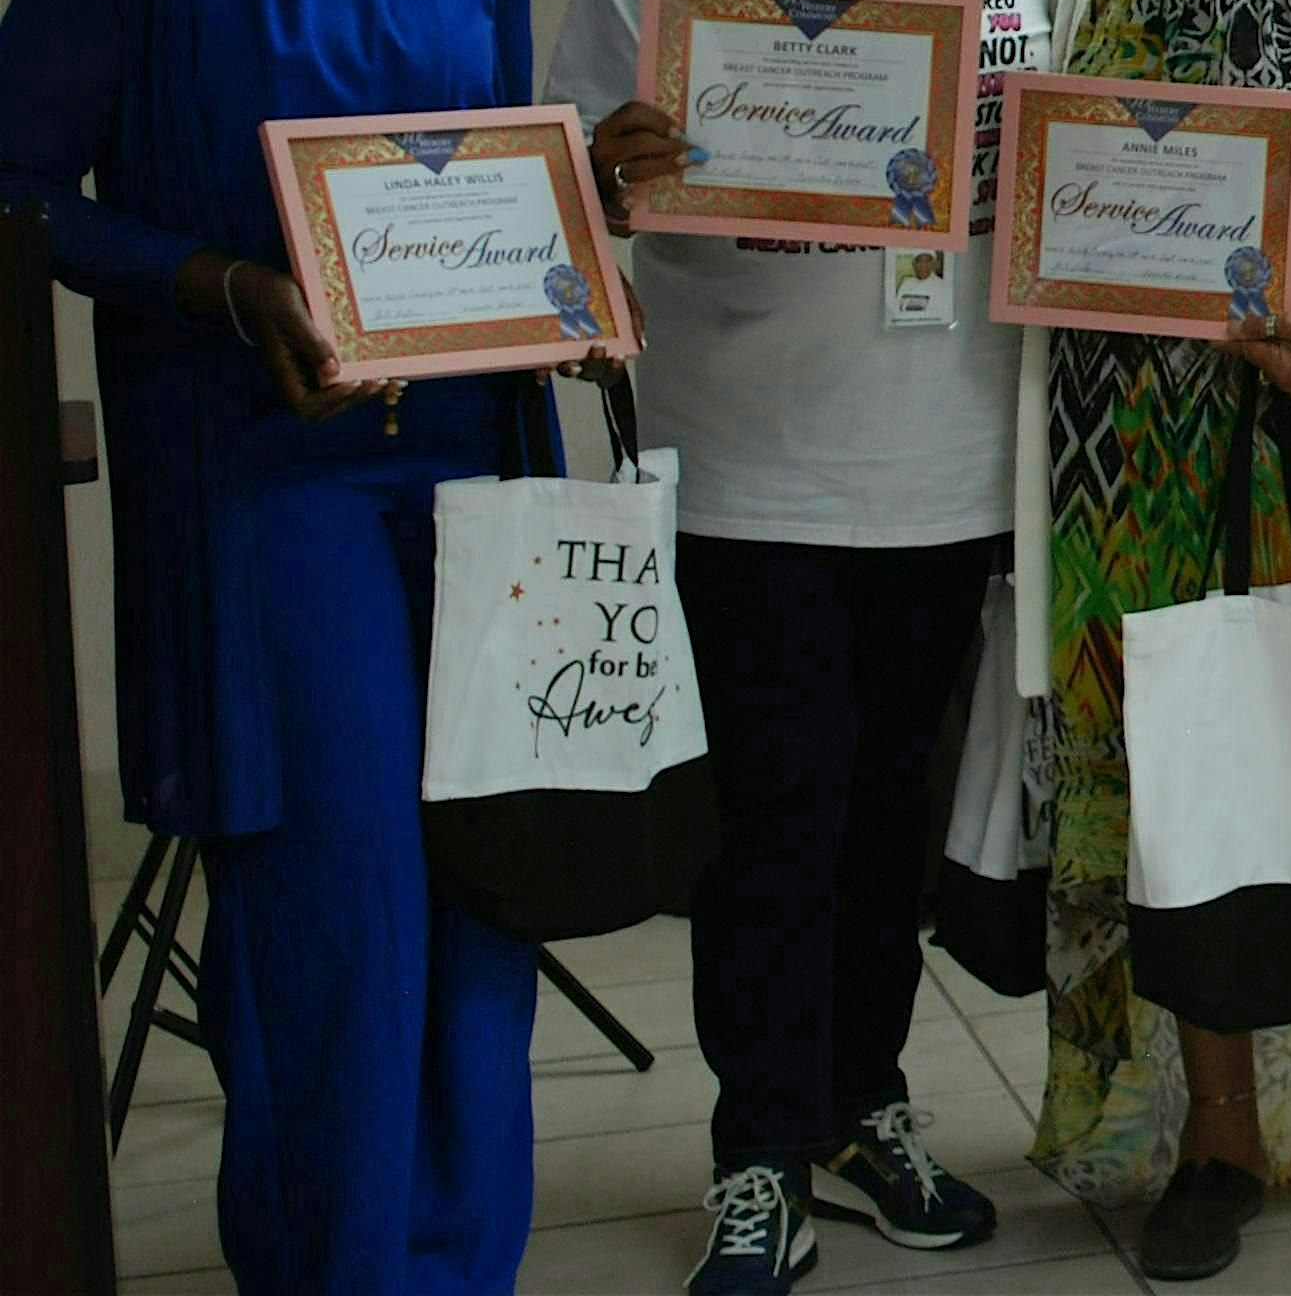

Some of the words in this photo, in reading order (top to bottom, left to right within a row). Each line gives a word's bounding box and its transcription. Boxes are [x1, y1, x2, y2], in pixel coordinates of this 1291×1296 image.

[988, 11, 1022, 33] YOU
[773, 40, 812, 53] BETTY
[816, 43, 857, 56] CLARK
[756, 64, 791, 75] CANCER
[696, 81, 816, 127] Service
[783, 104, 920, 144] Award
[1121, 141, 1158, 155] ANNIE
[1162, 144, 1199, 158] MILES
[1106, 164, 1137, 174] CANCER
[384, 178, 422, 191] LINDA
[424, 175, 462, 188] HALEY
[465, 172, 504, 185] WILLIS
[1051, 180, 1160, 224] Service
[1130, 203, 1256, 241] Award
[352, 223, 466, 272] Service
[440, 229, 558, 271] Award
[557, 539, 660, 584] THA
[588, 649, 630, 677] for
